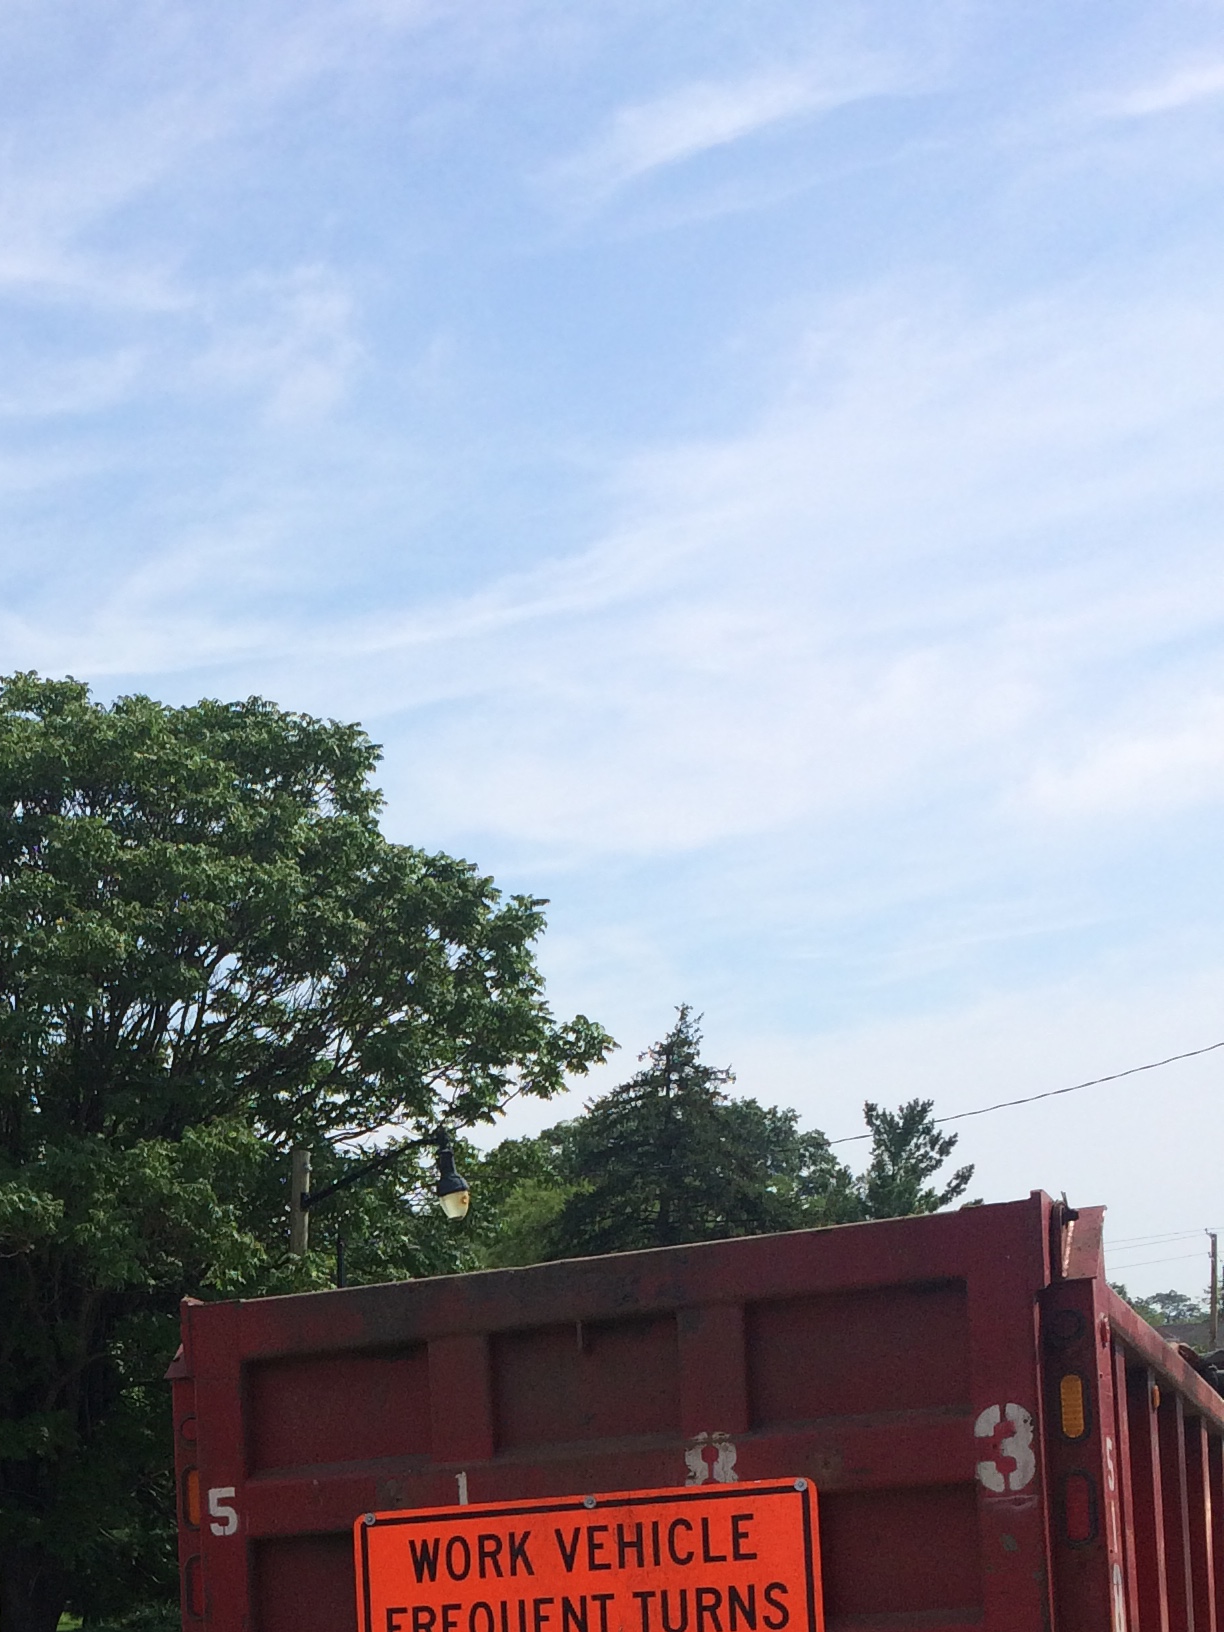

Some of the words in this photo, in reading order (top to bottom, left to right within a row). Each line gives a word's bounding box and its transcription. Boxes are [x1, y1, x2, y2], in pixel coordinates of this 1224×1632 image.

[208, 1486, 238, 1536] 5
[974, 1402, 1035, 1493] 3
[408, 1530, 535, 1584] WORK
[554, 1513, 758, 1573] VEHICLE
